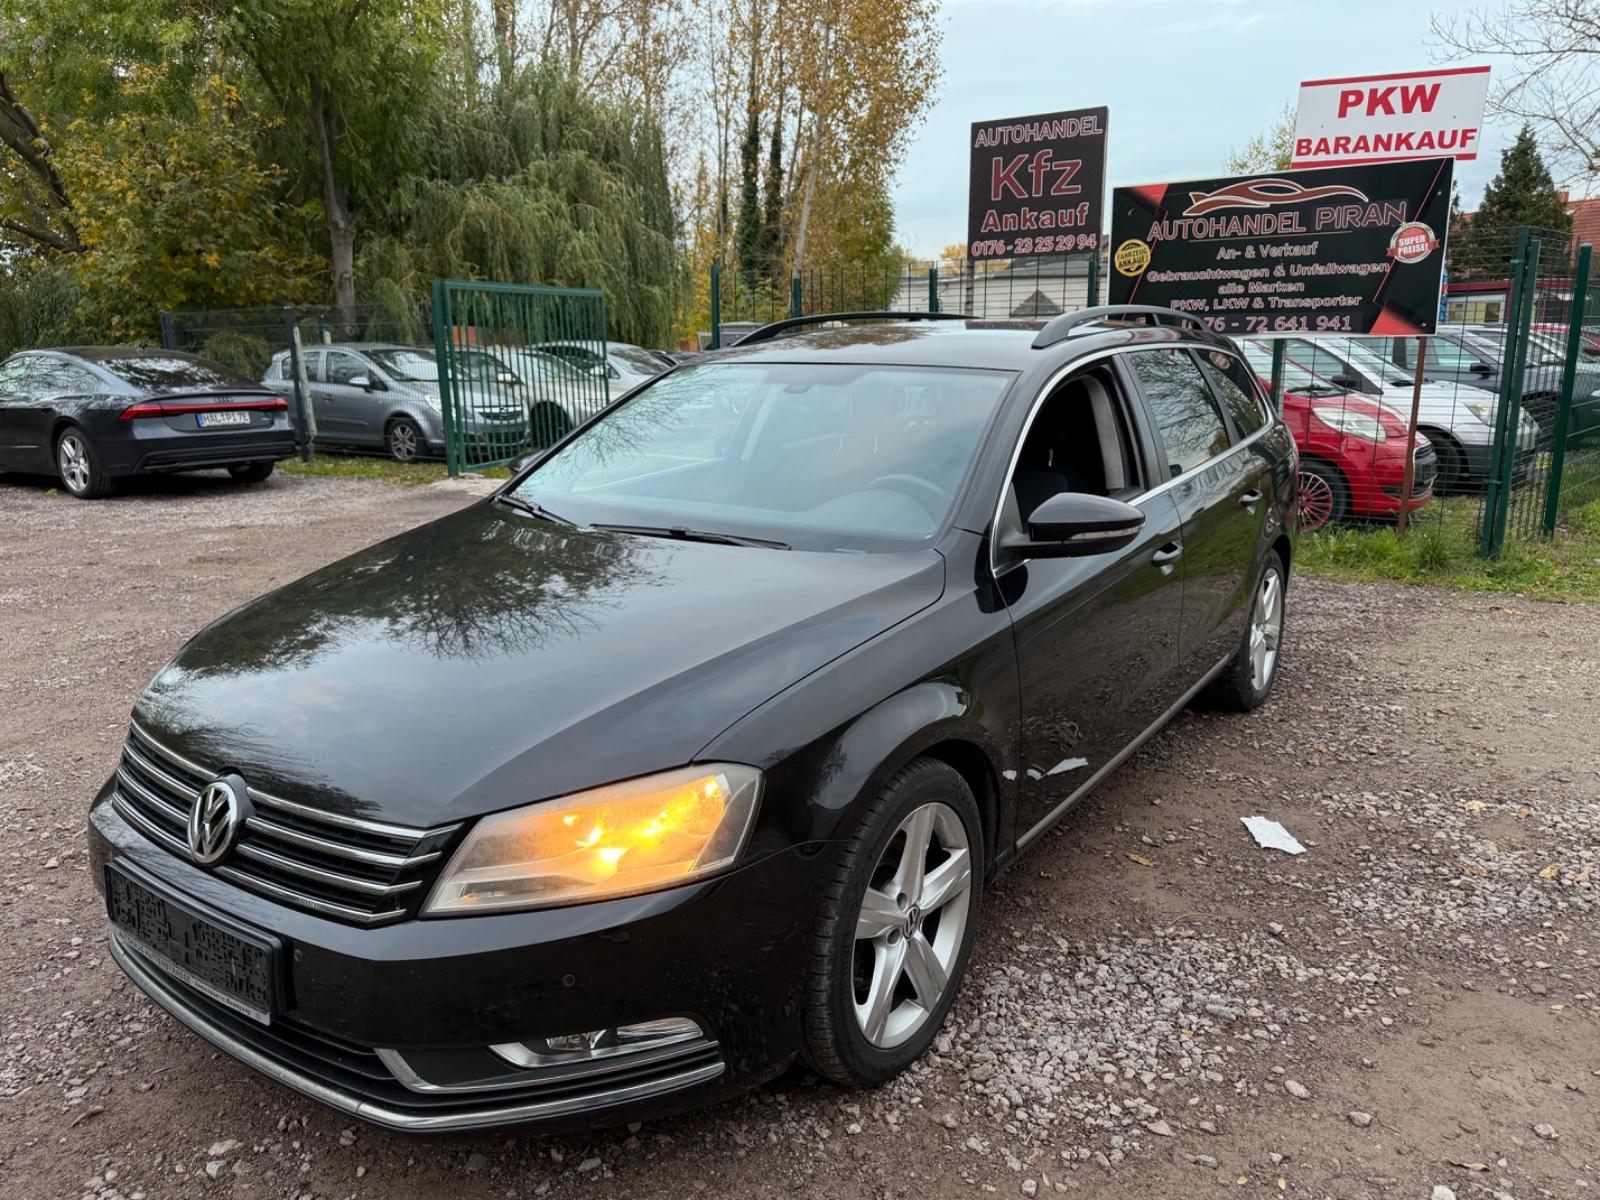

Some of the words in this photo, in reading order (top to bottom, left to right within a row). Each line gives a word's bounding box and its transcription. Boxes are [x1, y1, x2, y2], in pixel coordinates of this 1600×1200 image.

[1337, 83, 1441, 119] PKW
[974, 115, 1103, 148] AUTOHANDEL
[1295, 128, 1477, 157] BARANKAUF
[991, 149, 1082, 201] Kfz
[981, 202, 1089, 233] Ankauf
[1147, 211, 1306, 242] AUTOHANDEL
[1315, 201, 1407, 230] PIRAN
[1216, 247, 1242, 260] An-
[1244, 245, 1255, 259] &
[1259, 240, 1319, 257] Verkauf
[1398, 243, 1428, 257] PREISE!
[1399, 235, 1425, 247] SUPER
[1147, 266, 1270, 282] Gebrauchtwagen
[1273, 264, 1285, 277] &
[1289, 262, 1390, 276] Unfallwagen
[1218, 283, 1245, 295] alle
[1248, 280, 1304, 293] Marken
[1170, 299, 1210, 312] PKW,
[1213, 297, 1249, 310] LKW
[1252, 297, 1264, 309] &
[1268, 295, 1362, 310] Transporter
[1246, 316, 1268, 332] 72
[1274, 315, 1309, 331] 641
[1316, 315, 1352, 331] 941
